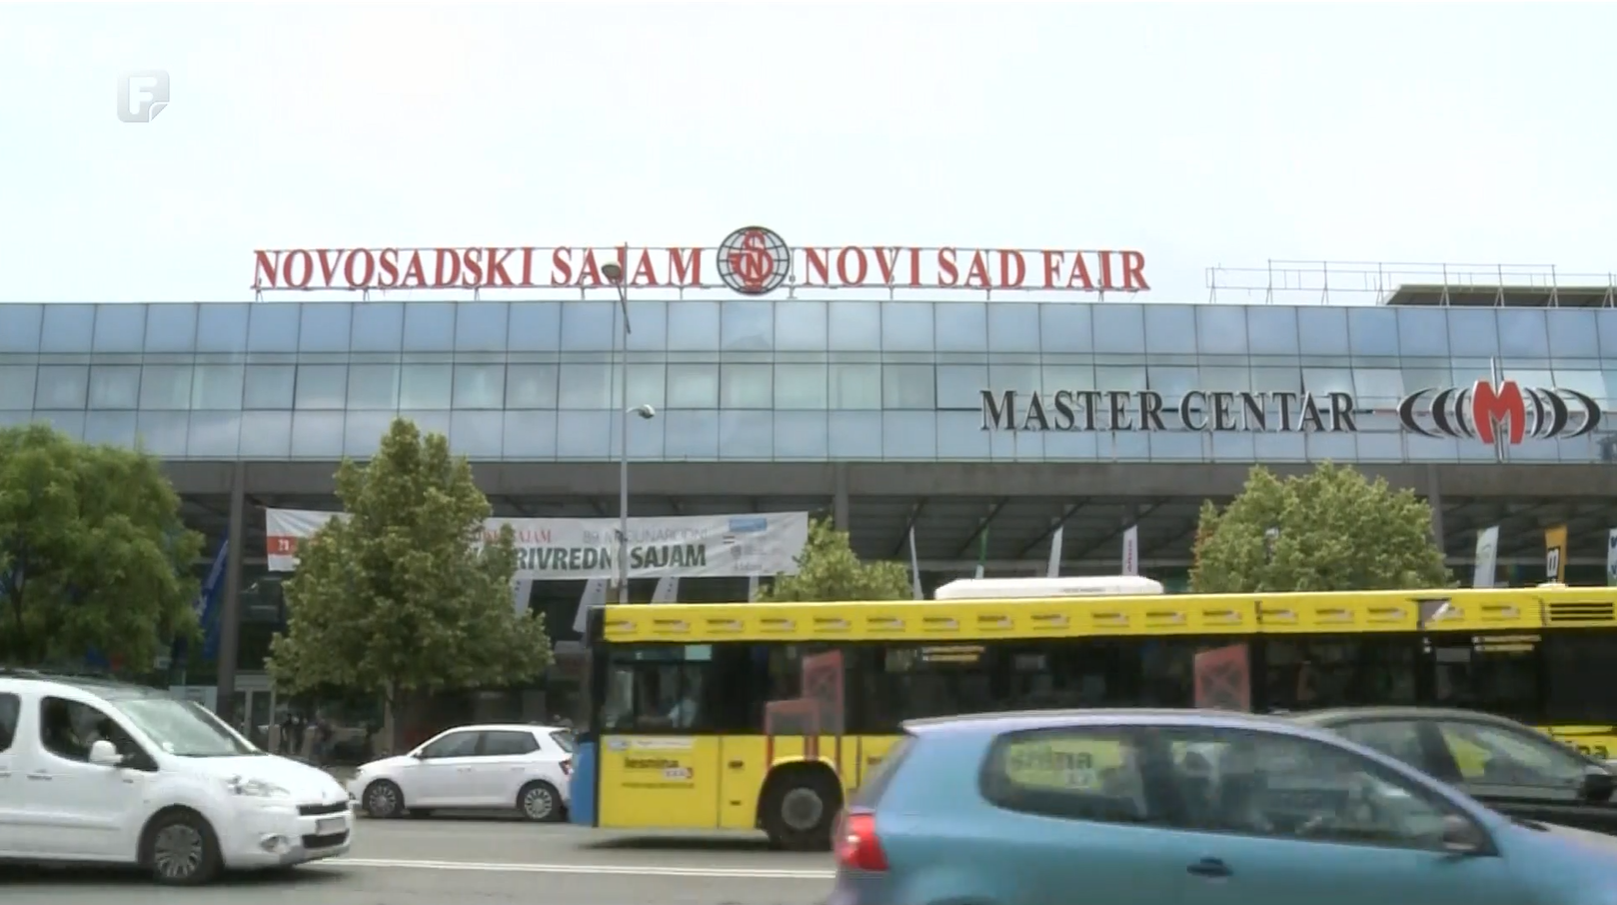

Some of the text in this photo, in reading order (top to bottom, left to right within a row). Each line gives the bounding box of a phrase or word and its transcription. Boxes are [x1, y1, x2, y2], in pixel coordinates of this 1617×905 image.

[253, 246, 704, 288] NOVOSADSKI SAJAM
[803, 246, 1150, 291] NOVI SAD FAIR
[979, 389, 1358, 432] MASTER CENTAR
[630, 544, 706, 569] SAJAM
